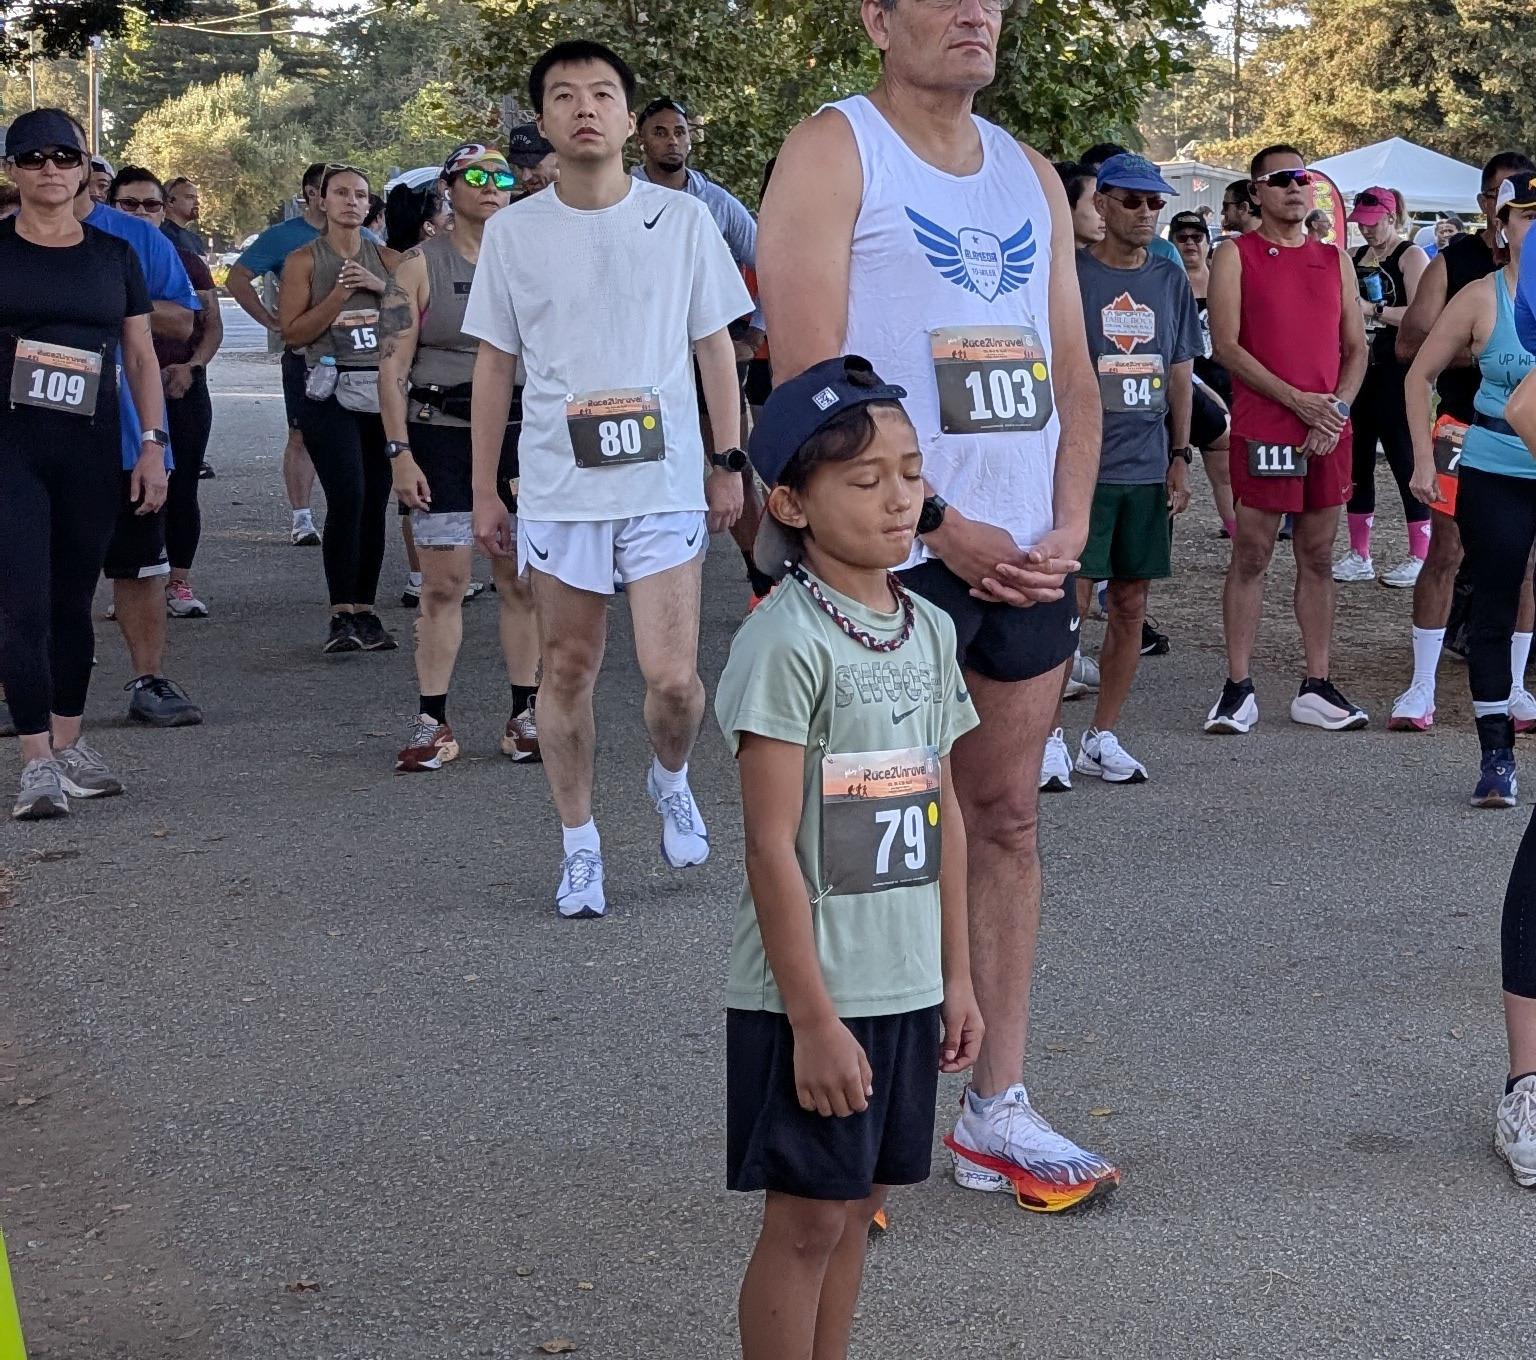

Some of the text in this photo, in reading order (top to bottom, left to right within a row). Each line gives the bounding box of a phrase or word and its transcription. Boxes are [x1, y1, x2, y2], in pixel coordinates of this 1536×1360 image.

[350, 327, 377, 350] 15
[962, 338, 1024, 348] Race2Unravel
[1499, 353, 1515, 365] UP
[28, 369, 85, 405] 109
[965, 369, 1037, 420] 103
[1122, 378, 1151, 405] 84
[588, 397, 642, 407] Race2Unravel
[598, 419, 641, 456] 80
[1257, 445, 1295, 470] 111
[864, 762, 926, 782] Race2Unravel
[875, 805, 926, 875] 79
